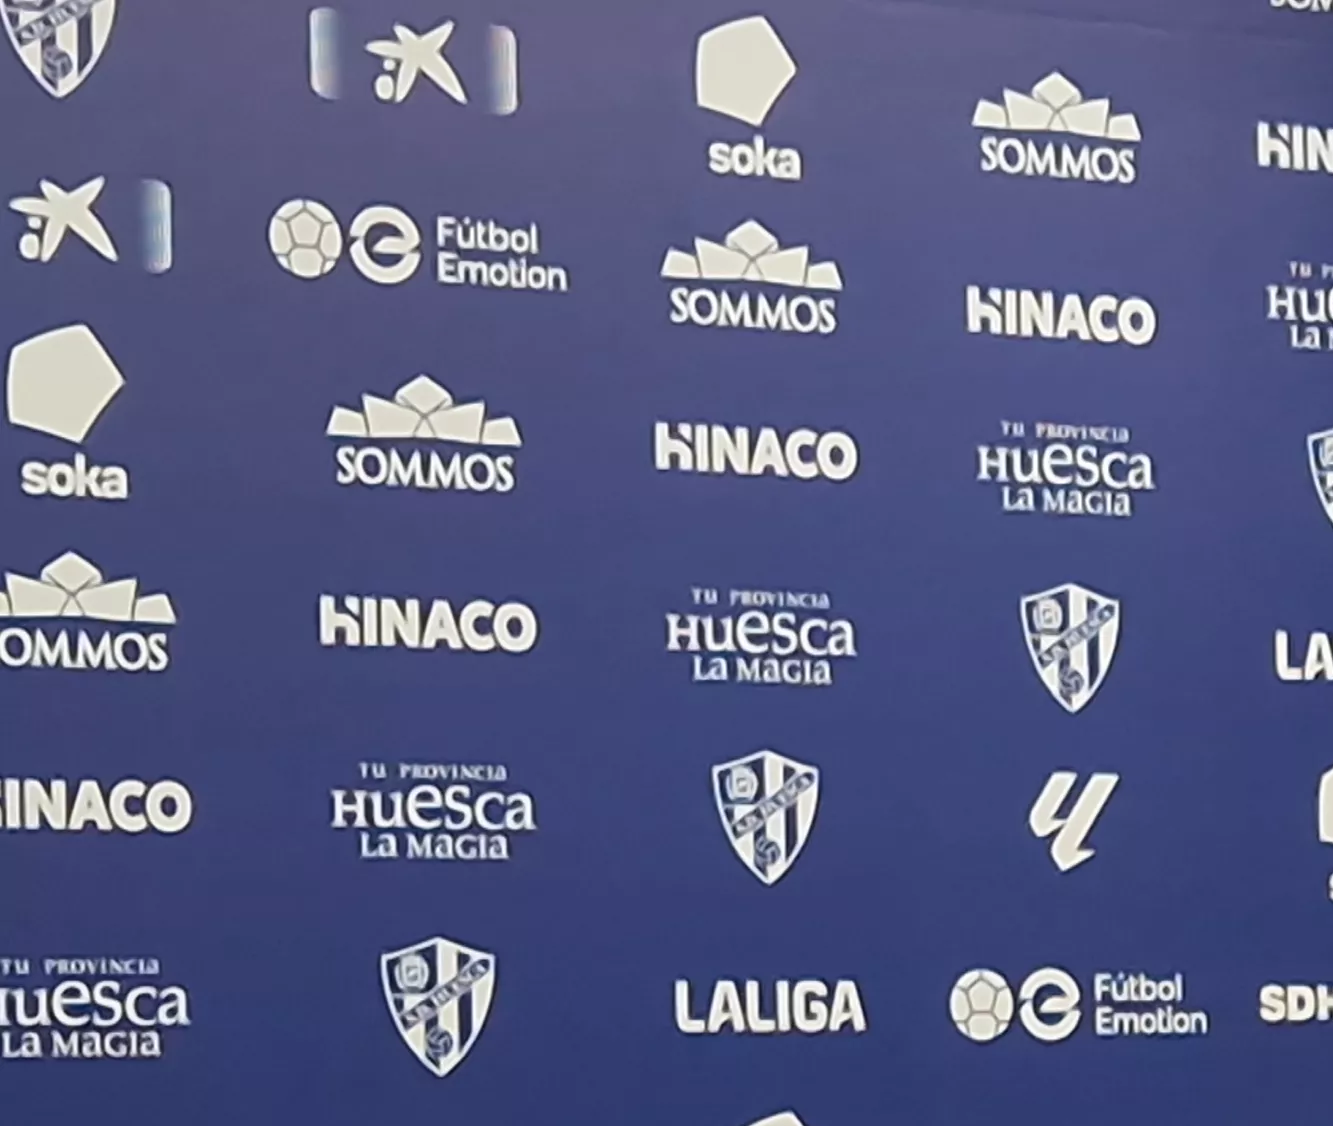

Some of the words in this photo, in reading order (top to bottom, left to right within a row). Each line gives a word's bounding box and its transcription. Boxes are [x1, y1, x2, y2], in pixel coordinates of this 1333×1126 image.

[708, 135, 801, 180] soka
[980, 136, 1136, 184] SOMMOS
[437, 216, 538, 254] Fútbol
[437, 252, 568, 291] Emotion
[670, 286, 837, 334] SOMMOS
[966, 285, 1156, 345] HINACO
[336, 446, 514, 492] SOMMOS
[655, 421, 858, 480] HINACO
[977, 443, 1155, 490] Huesca
[21, 452, 128, 499] soka
[319, 594, 537, 652] HINACO
[666, 610, 857, 656] Huesca
[0, 627, 169, 671] OMMOS
[0, 777, 192, 833] INACO
[331, 784, 537, 831] Huesca
[675, 979, 866, 1033] LALIGA
[1094, 972, 1183, 1002] Fútbol
[1095, 1005, 1208, 1035] Emotion
